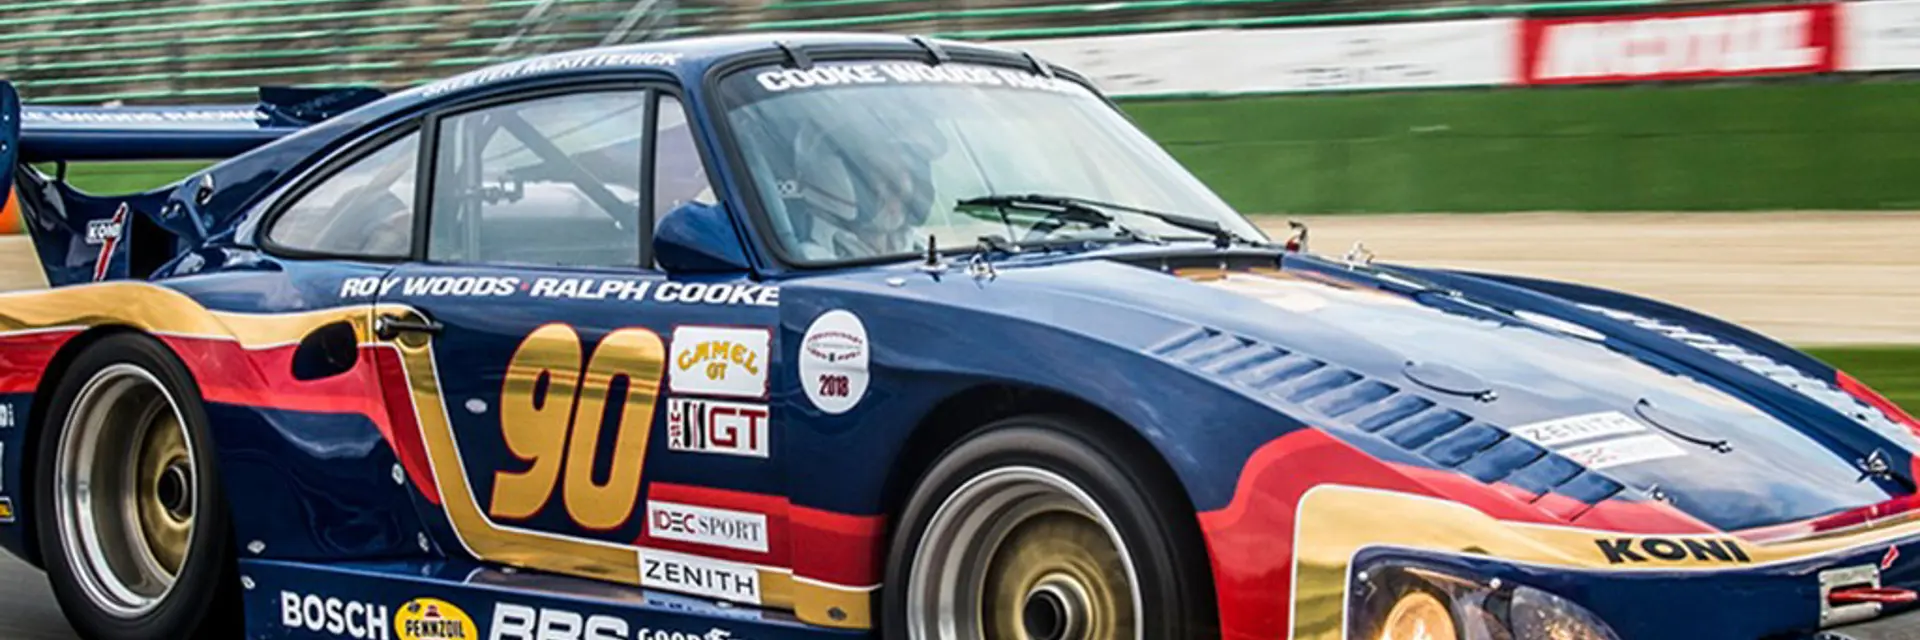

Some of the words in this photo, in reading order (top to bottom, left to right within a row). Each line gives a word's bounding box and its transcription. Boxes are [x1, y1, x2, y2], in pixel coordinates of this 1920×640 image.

[755, 62, 888, 92] COOKE
[880, 62, 1002, 86] WOODS
[340, 276, 401, 298] ROY
[402, 276, 519, 297] WOODS
[529, 277, 651, 301] RALPH
[653, 281, 780, 307] COOKE
[677, 341, 759, 376] CAMEL
[706, 362, 728, 381] GT
[819, 374, 850, 397] 2018
[488, 321, 666, 531] 90
[708, 405, 768, 450] GT
[652, 509, 696, 534] IDEC
[698, 516, 762, 542] SPORT
[1594, 537, 1752, 565] KONI
[645, 558, 755, 596] ZENITH
[281, 590, 390, 640] BOSCH
[405, 619, 466, 639] PENNZOIL
